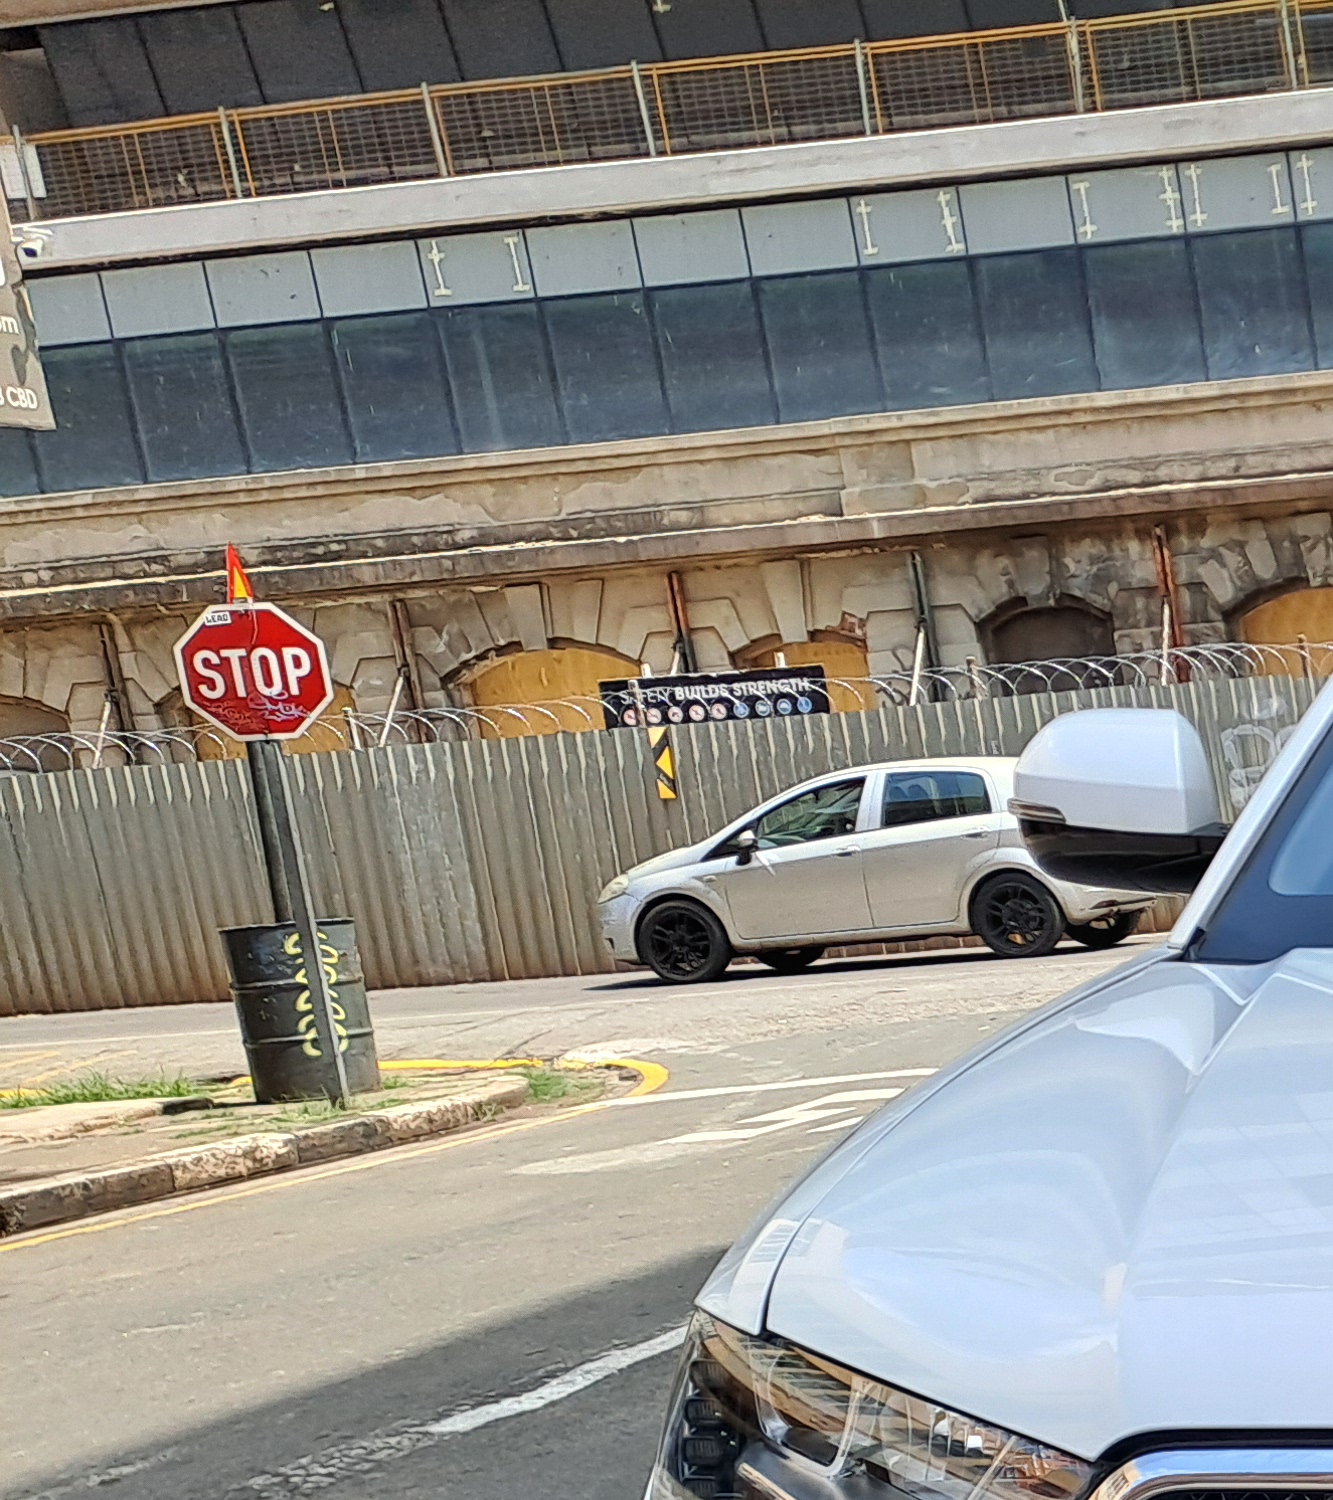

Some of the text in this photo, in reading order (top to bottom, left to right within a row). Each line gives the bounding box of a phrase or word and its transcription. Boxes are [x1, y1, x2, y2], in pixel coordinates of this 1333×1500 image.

[6, 386, 38, 409] CBD
[192, 646, 311, 700] STOP
[674, 684, 730, 701] BUILDS
[732, 677, 812, 697] STRENGTH
